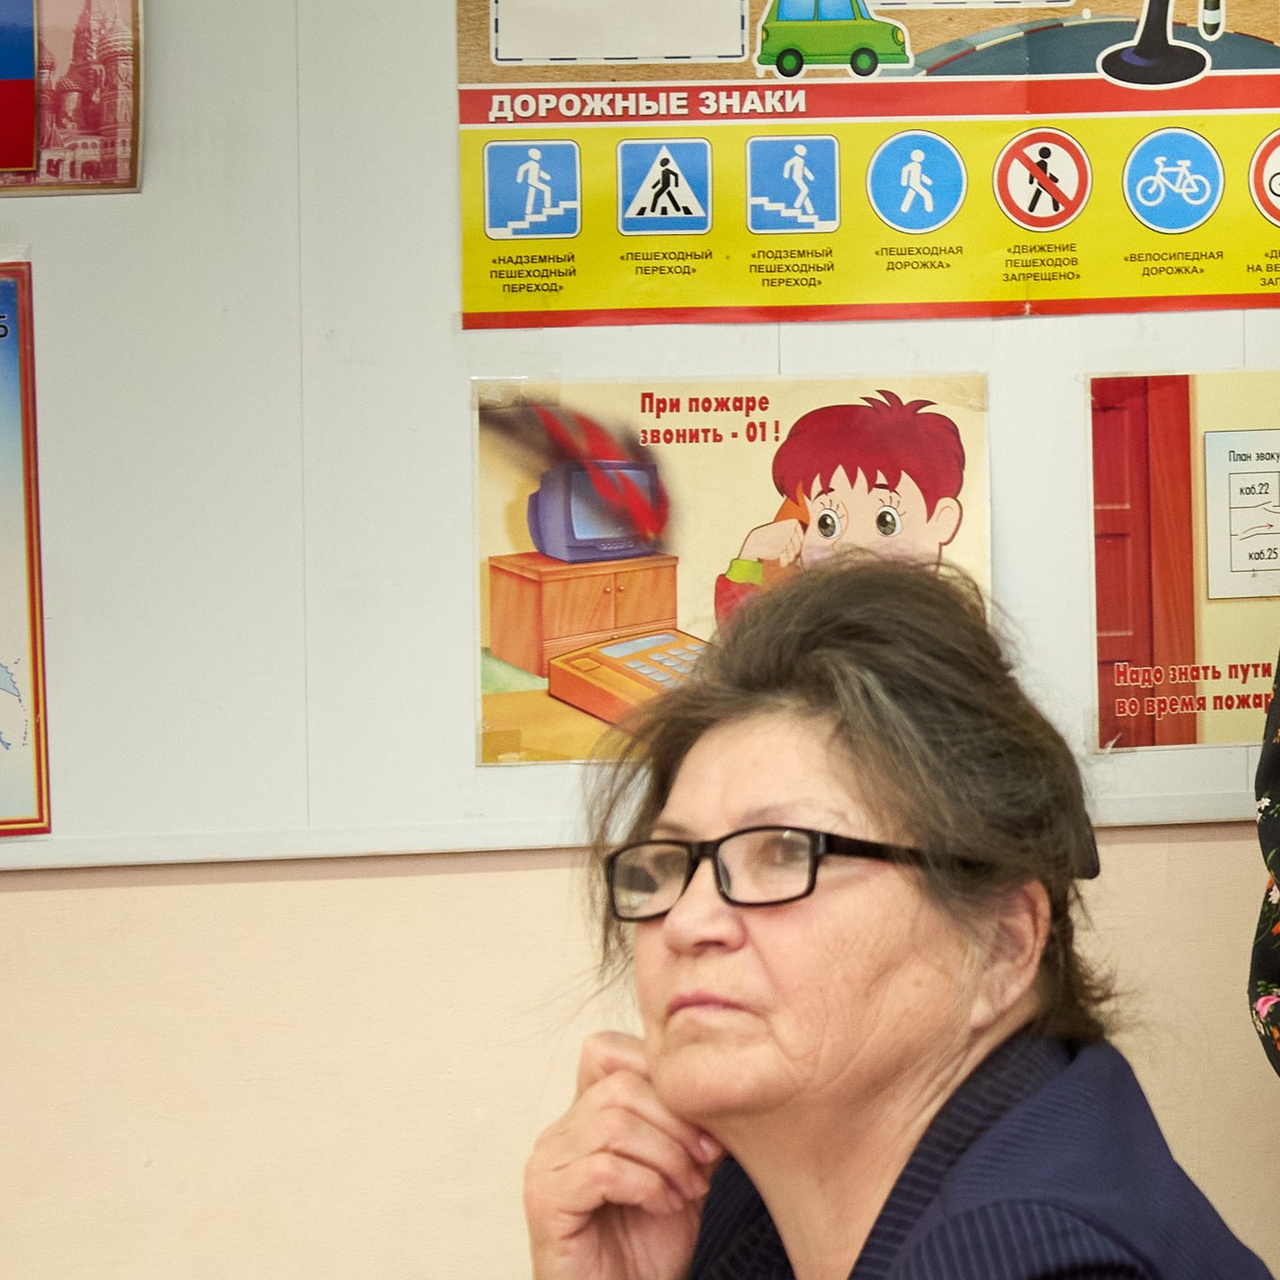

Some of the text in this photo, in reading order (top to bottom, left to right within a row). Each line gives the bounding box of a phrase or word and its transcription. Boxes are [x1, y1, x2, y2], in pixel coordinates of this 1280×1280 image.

[488, 90, 805, 120] ДОРОЖНЫЕ ЗНАКИ
[751, 247, 832, 259] «ПОДЗЕМНЫЙ
[874, 246, 962, 256] «ПЕШЕХОДНАЯ
[1007, 243, 1076, 254] «ДВИЖЕНИЕ
[492, 253, 574, 265] «НАДЗЕМНЫЙ
[619, 250, 712, 261] «ПЕШЕХОДНЫЙ
[1123, 251, 1223, 262] «ВЕЛОСИПЕДНАЯ
[749, 262, 834, 274] ПЕШЕХОДНЫЙ
[886, 260, 950, 270] ДОРОЖКА»
[1005, 257, 1078, 268] ПЕШЕХОДОВ
[1246, 264, 1262, 272] НА
[490, 266, 576, 279] ПЕШЕХОДНЫЙ
[635, 265, 696, 275] ПЕРЕХОД»
[1141, 266, 1204, 276] ДОРОЖКА»
[762, 277, 822, 287] ПЕРЕХОД»
[1002, 271, 1080, 282] ЗАПРЕЩЕНО»
[502, 283, 563, 293] ПЕРЕХОД»
[640, 392, 769, 418] При пожаре
[640, 427, 723, 445] звонить
[1228, 449, 1251, 461] План
[1239, 482, 1269, 495] каб.22
[1248, 547, 1278, 560] каб.25
[1114, 662, 1272, 688] Надо знать пути
[1115, 692, 1274, 720] во время пожар
